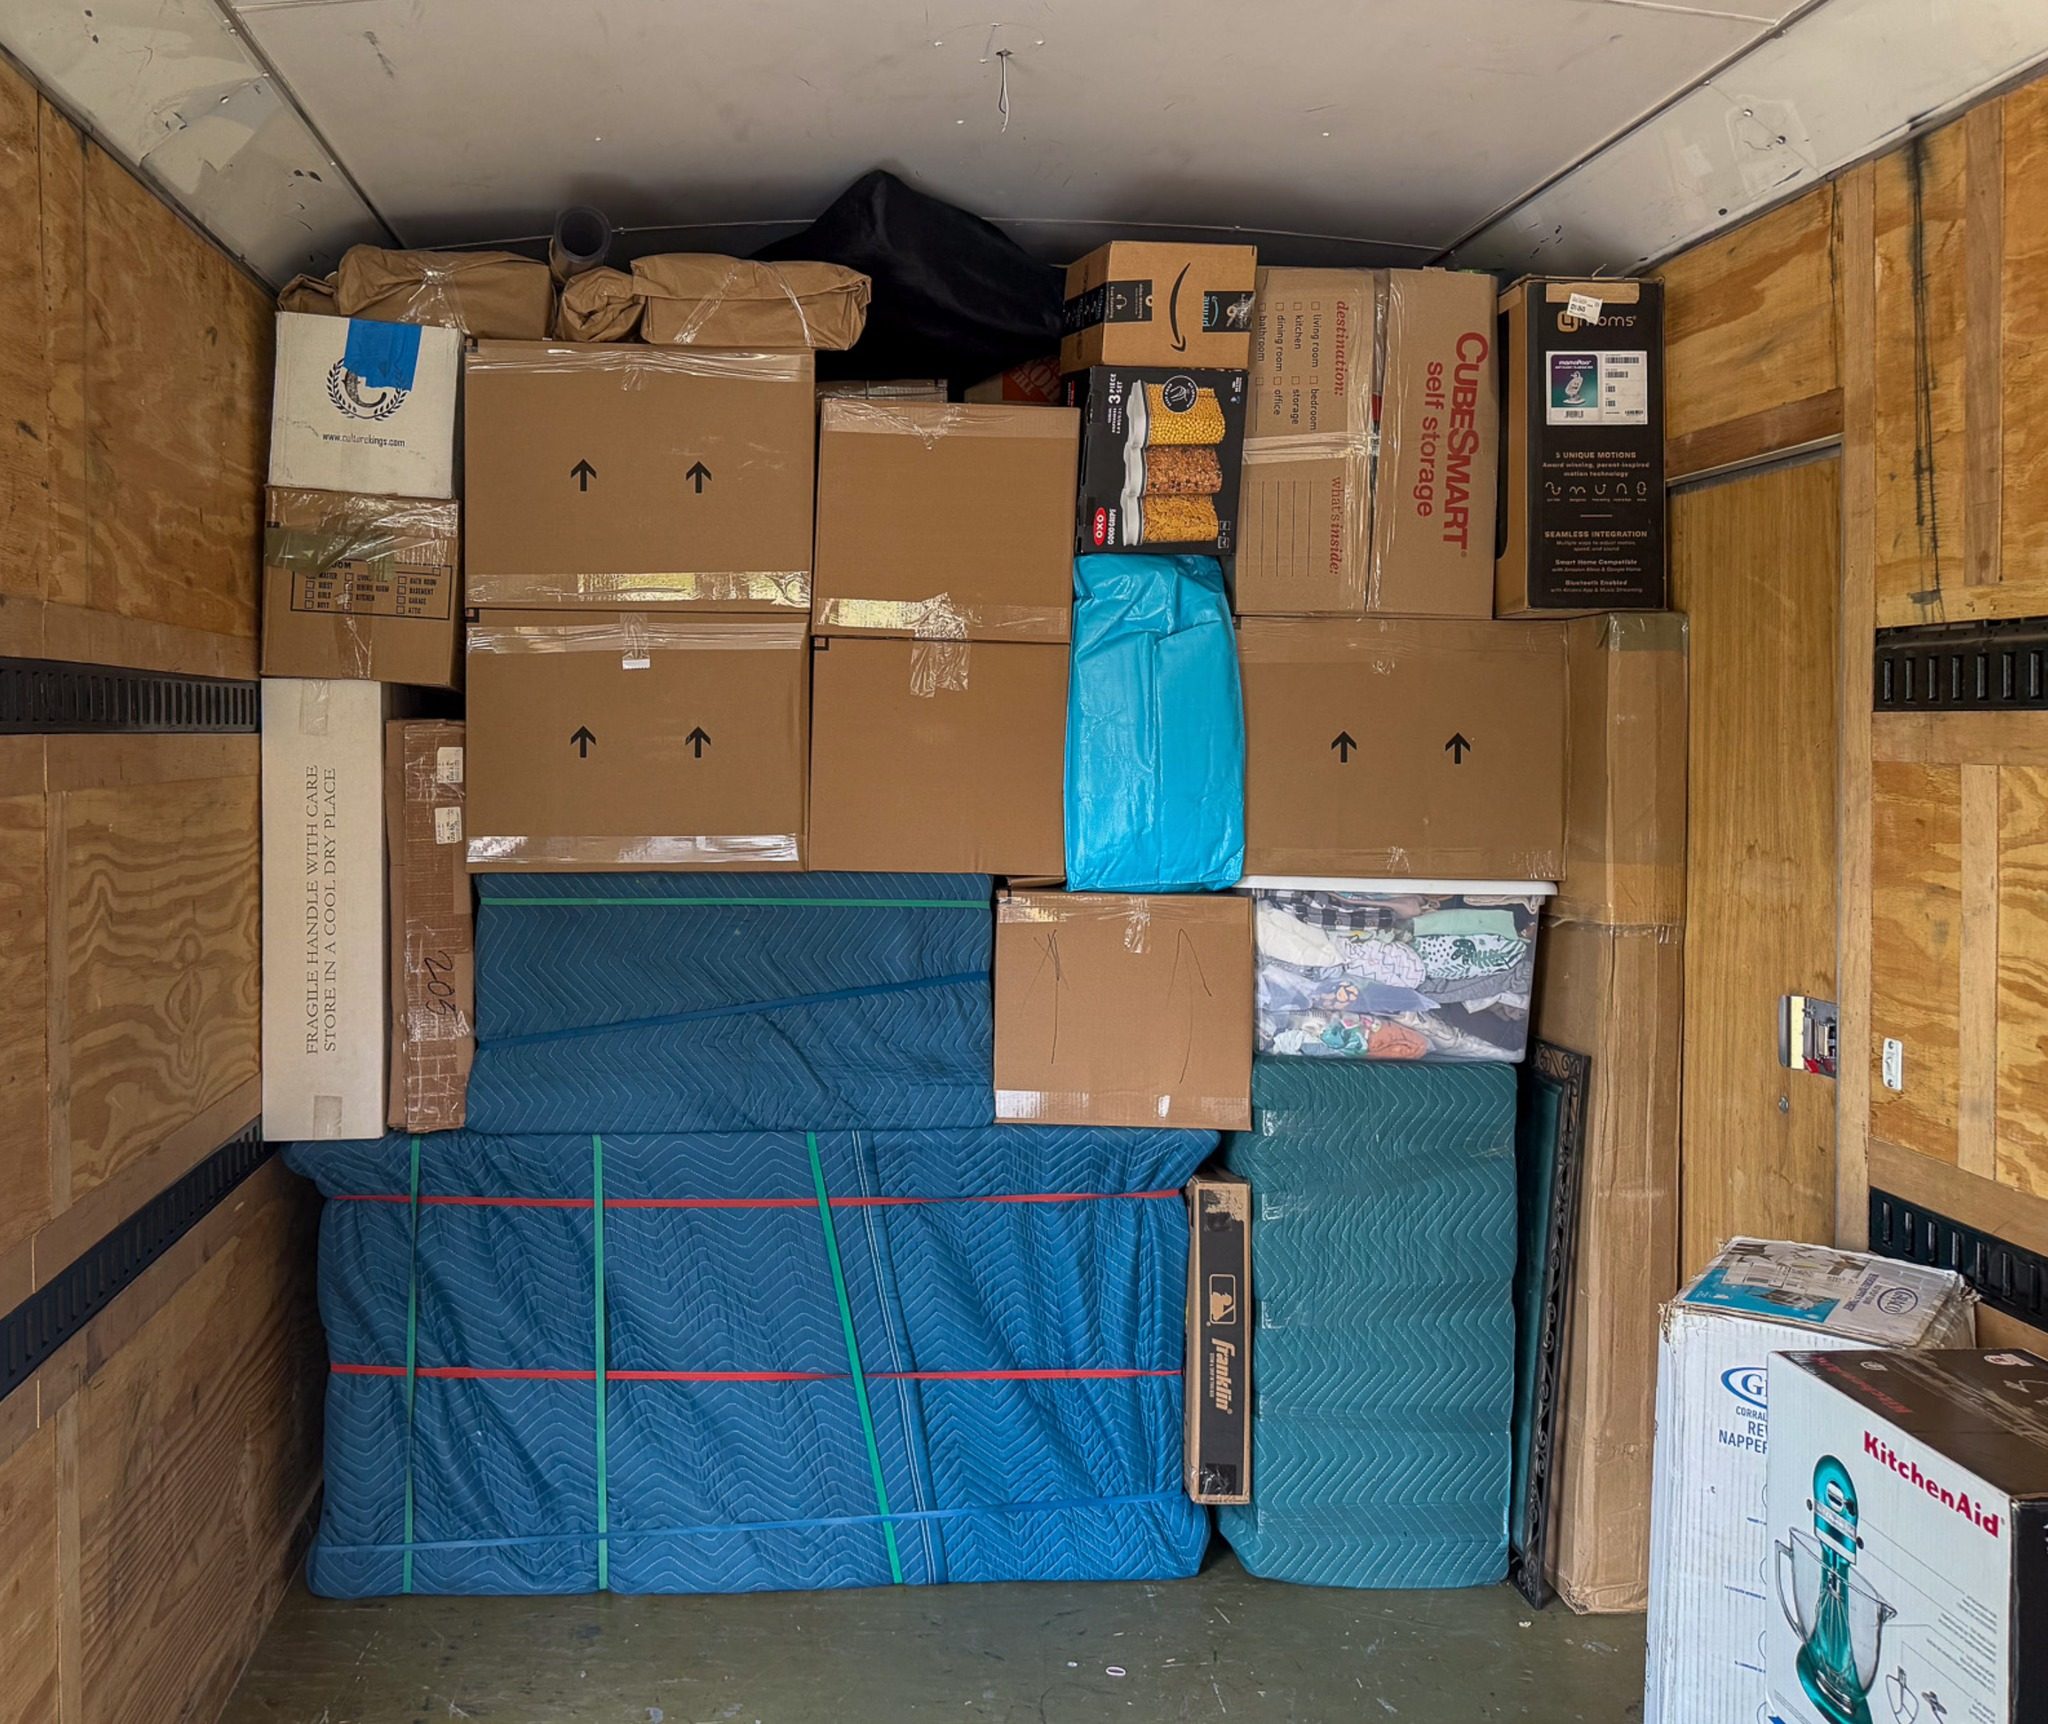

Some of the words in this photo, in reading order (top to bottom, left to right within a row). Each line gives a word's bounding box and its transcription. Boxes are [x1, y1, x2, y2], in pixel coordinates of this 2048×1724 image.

[1257, 315, 1268, 362] bathroom
[1274, 314, 1286, 345] dining
[1294, 314, 1304, 350] kitchen
[1310, 314, 1322, 343] living
[1334, 301, 1349, 396] destination:
[1275, 346, 1283, 372] room
[1311, 343, 1319, 368] room
[1108, 394, 1121, 404] 3
[1273, 389, 1283, 416] office
[1290, 389, 1301, 425] storage
[1424, 361, 1446, 411] self
[1310, 388, 1320, 431] bedroom
[1413, 416, 1441, 517] storage
[1597, 451, 1637, 459] MOTIONS
[1331, 477, 1345, 521] what's
[1095, 514, 1104, 539] OXO
[1107, 527, 1116, 545] GOOD
[1330, 521, 1343, 575] inside:
[306, 765, 319, 818] CARE
[323, 768, 337, 829] PLACE
[306, 823, 319, 876] WITH
[323, 834, 337, 876] DRY
[306, 880, 319, 964] HANDLE
[323, 879, 337, 937] COOL
[324, 941, 337, 955] A
[324, 960, 337, 983] IN
[306, 970, 319, 1055] FRAGILE
[323, 987, 337, 1052] STORE
[1863, 1430, 1999, 1538] KitchenAid
